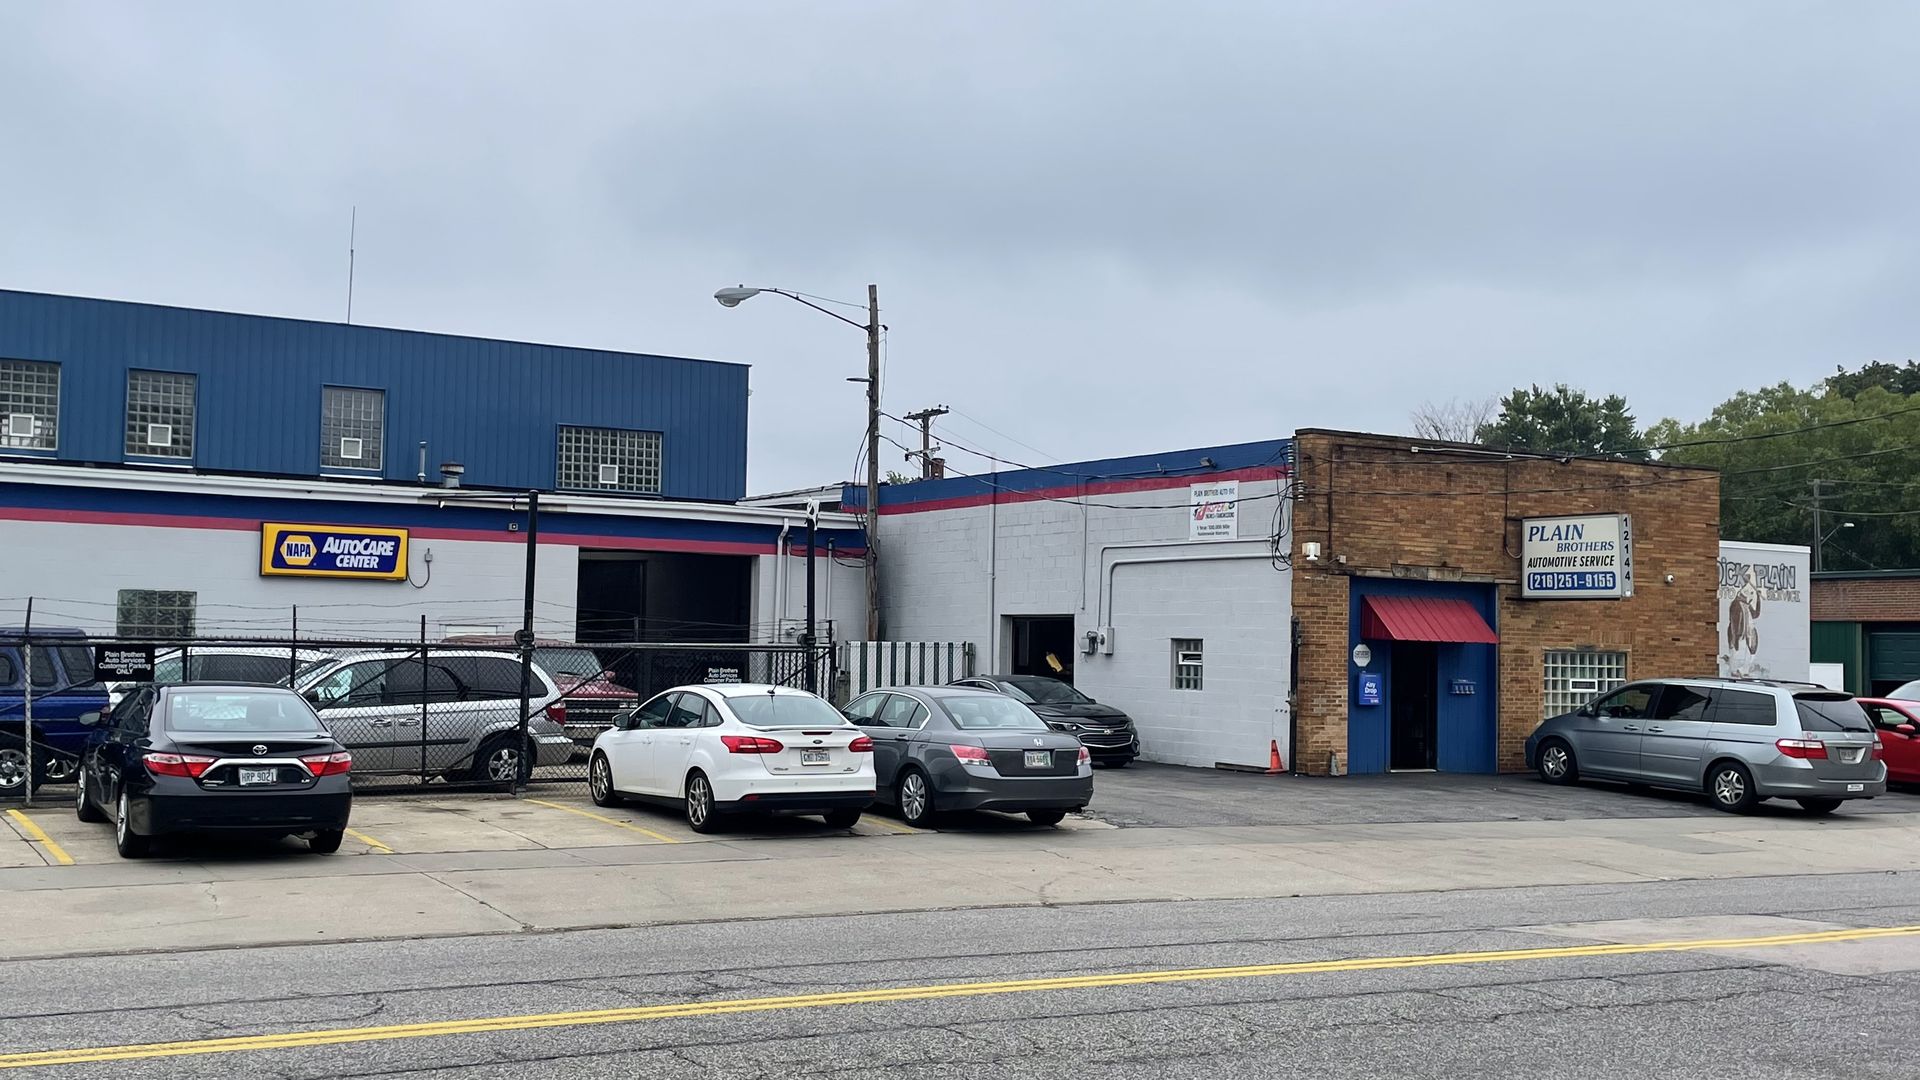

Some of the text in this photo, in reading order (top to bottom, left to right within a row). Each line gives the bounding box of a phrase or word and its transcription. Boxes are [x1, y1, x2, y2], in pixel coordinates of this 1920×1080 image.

[1528, 523, 1585, 542] PLAIN
[286, 542, 311, 557] NAPA
[1556, 541, 1615, 553] BROTHERS
[335, 554, 380, 569] CENTER
[1527, 555, 1615, 568] AUTOMOTIVE SERVICE
[1529, 573, 1614, 590] (216)251-9155
[1364, 687, 1378, 695] Drop
[241, 771, 274, 783] HRP 9021
